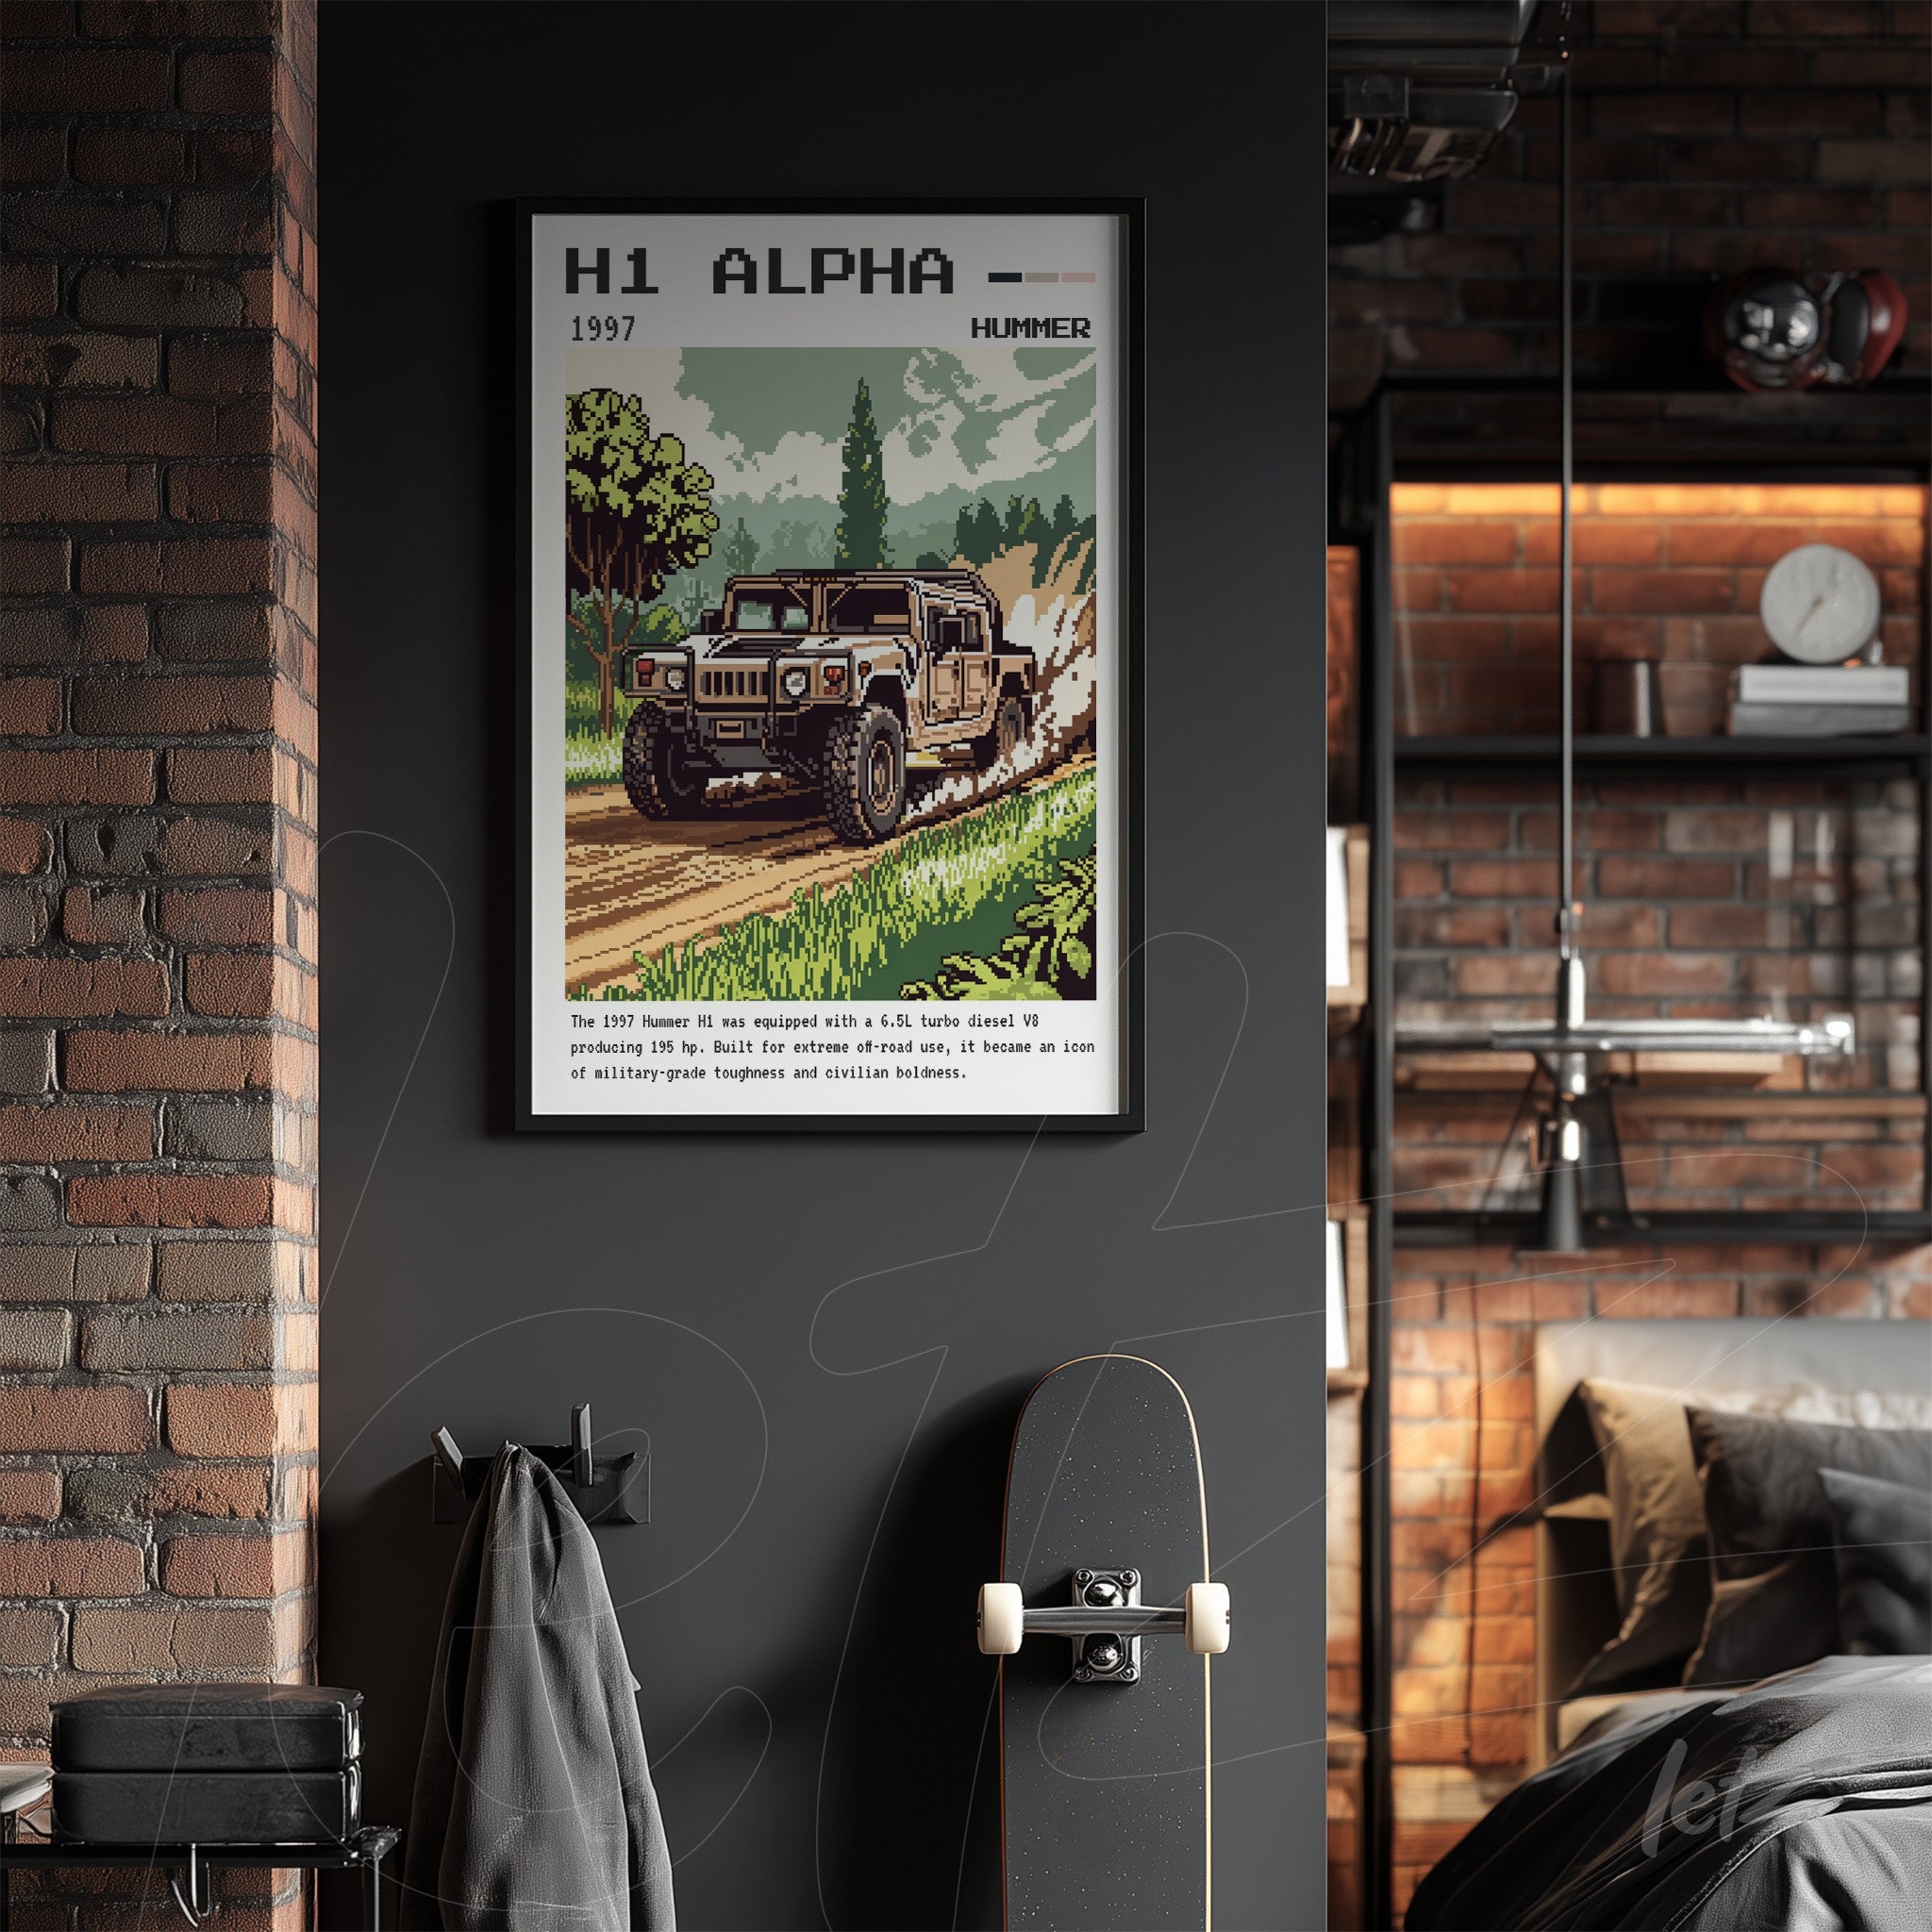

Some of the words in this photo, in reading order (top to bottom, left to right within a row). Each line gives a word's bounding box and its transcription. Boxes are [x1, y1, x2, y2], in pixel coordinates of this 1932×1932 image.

[566, 248, 658, 293] H1
[713, 248, 954, 293] ALPHA
[572, 316, 635, 341] 1997
[972, 318, 1091, 338] HUMMER
[571, 1014, 595, 1028] The
[603, 1014, 635, 1028] 1997
[642, 1014, 691, 1028] Hummer
[698, 1014, 714, 1028] H1
[722, 1018, 746, 1028] was
[753, 1013, 818, 1031] equipped
[824, 1013, 858, 1028] with
[864, 1017, 873, 1028] a
[880, 1013, 912, 1028] 6.5L
[920, 1013, 960, 1028] turbo
[967, 1013, 1015, 1027] diesel
[1023, 1013, 1039, 1027] V8
[571, 1040, 642, 1058] producing
[651, 1040, 675, 1054] 195
[682, 1040, 704, 1058] hp.
[713, 1040, 754, 1054] Built
[762, 1040, 786, 1054] for
[793, 1040, 849, 1054] extreme
[857, 1040, 913, 1054] off-road
[920, 1042, 950, 1057] use,
[960, 1040, 975, 1053] it
[983, 1040, 1032, 1053] became
[1039, 1042, 1056, 1053] an
[1063, 1040, 1095, 1053] icon
[571, 1066, 587, 1079] of
[594, 1066, 707, 1083] military-grade
[713, 1066, 785, 1083] toughness
[792, 1065, 818, 1079] and
[824, 1065, 889, 1079] civilian
[896, 1065, 966, 1079] boldness.
